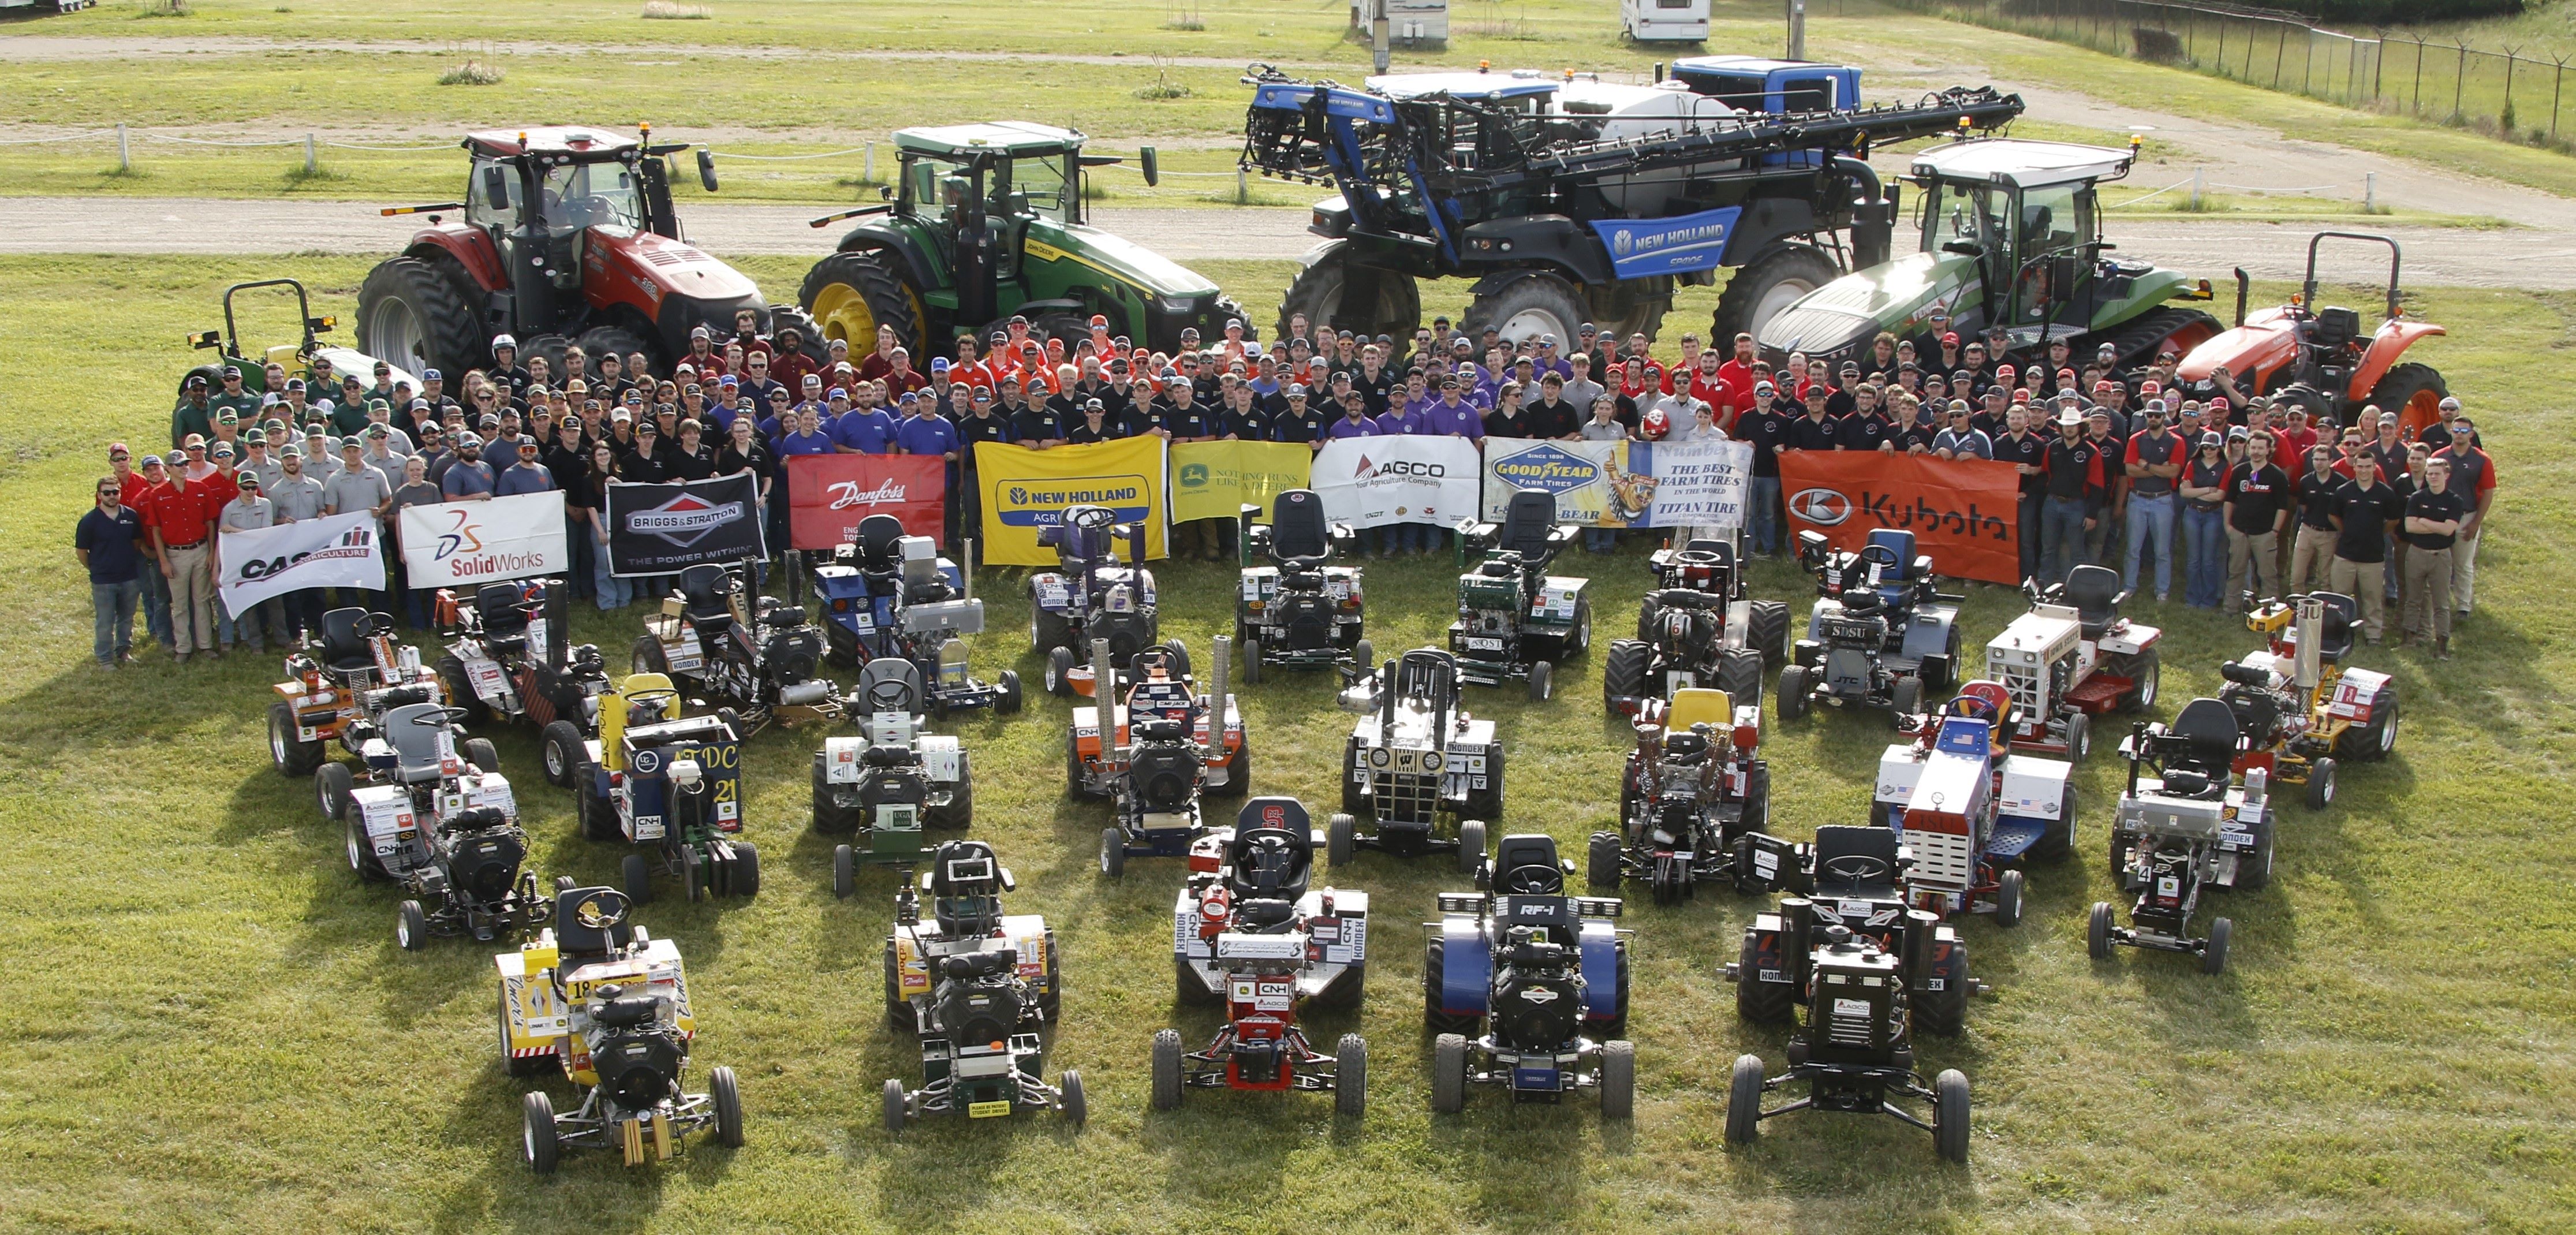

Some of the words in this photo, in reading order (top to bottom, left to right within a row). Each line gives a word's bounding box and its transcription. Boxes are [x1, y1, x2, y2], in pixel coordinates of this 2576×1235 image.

[1636, 233, 1664, 251] NEW
[1667, 224, 1723, 243] HOLLAND
[1026, 242, 1039, 252] JOHN
[1039, 247, 1055, 256] DEERE
[641, 277, 657, 294] 380
[1658, 444, 1732, 457] Number
[1380, 461, 1445, 478] AGCO
[1671, 465, 1700, 475] THE
[1703, 464, 1736, 475] BEST
[1216, 477, 1240, 487] LIKE
[1268, 473, 1298, 484] RUNS
[1370, 476, 1406, 488] Agriculture
[1408, 476, 1442, 488] Company
[1660, 476, 1700, 486] FARM
[1703, 475, 1741, 486] TIRES
[826, 477, 906, 510] Danfoss
[1032, 492, 1065, 504] NEW
[1069, 487, 1136, 503] HOLLAND
[1492, 505, 1510, 514] 1-8
[1658, 501, 1703, 514] TITAN
[1705, 502, 1738, 514] TIRE
[634, 518, 678, 527] BRIGGS
[686, 507, 736, 525] STRATTON
[1862, 491, 2007, 541] Kubota
[451, 550, 544, 577] SolidWorks
[628, 557, 652, 566] THE
[656, 553, 703, 564] POWER
[1832, 625, 1866, 639] SDSU
[373, 637, 387, 672] NDSU
[466, 666, 485, 698] MacDon
[1834, 676, 1859, 684] JTC
[1451, 744, 1484, 753] KONDEX
[714, 778, 737, 803] 21
[638, 818, 659, 826] CNH
[2139, 867, 2149, 881] 4
[1520, 904, 1555, 916] RF-1
[1176, 913, 1186, 950] KONDEX
[1189, 914, 1197, 938] CNH
[1343, 919, 1352, 943] CNH
[1354, 921, 1364, 958] KONDEX
[1219, 941, 1231, 956] 3
[1289, 942, 1302, 957] 3
[574, 982, 591, 999] 18
[1262, 985, 1286, 993] CNH
